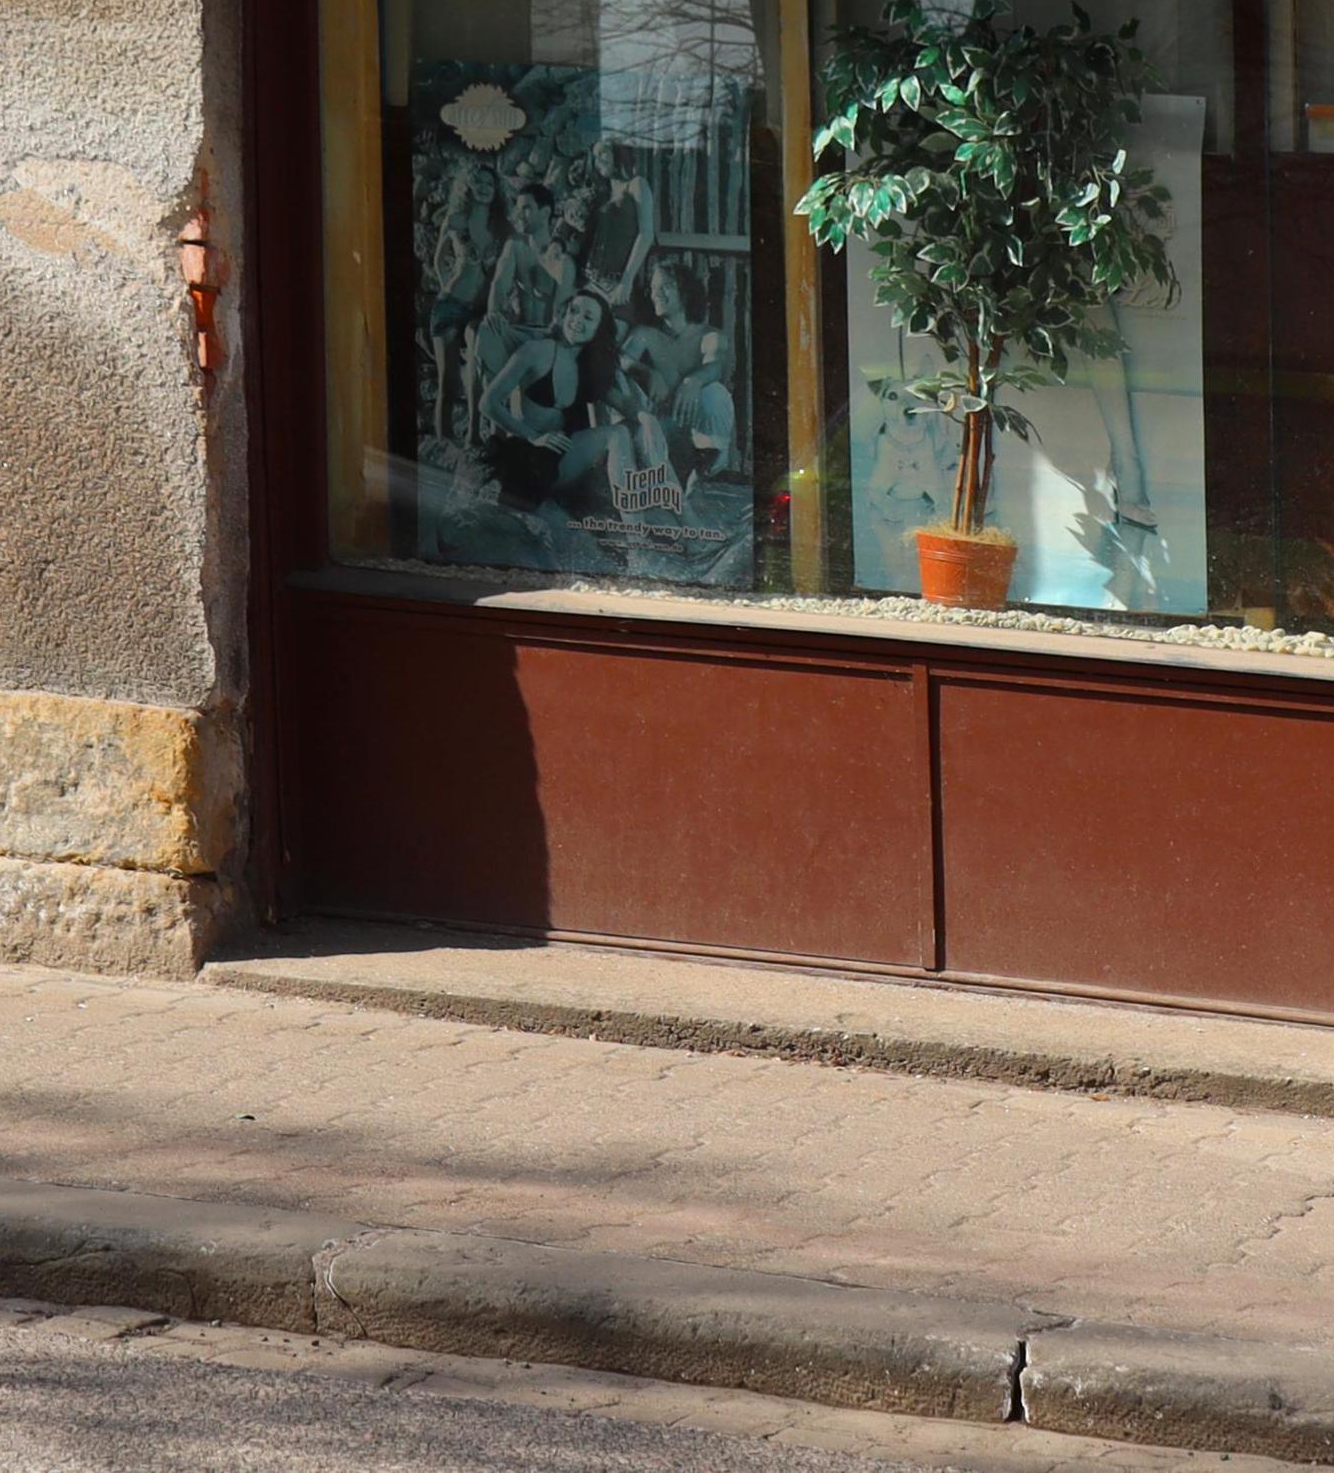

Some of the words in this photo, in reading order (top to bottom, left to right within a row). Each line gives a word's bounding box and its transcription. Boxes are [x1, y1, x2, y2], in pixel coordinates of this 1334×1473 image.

[624, 463, 667, 491] Trend
[612, 483, 683, 513] Tanology
[583, 517, 605, 531] the
[607, 520, 650, 537] trendy
[652, 524, 681, 541] way
[682, 525, 697, 538] to
[699, 528, 727, 542] tan.
